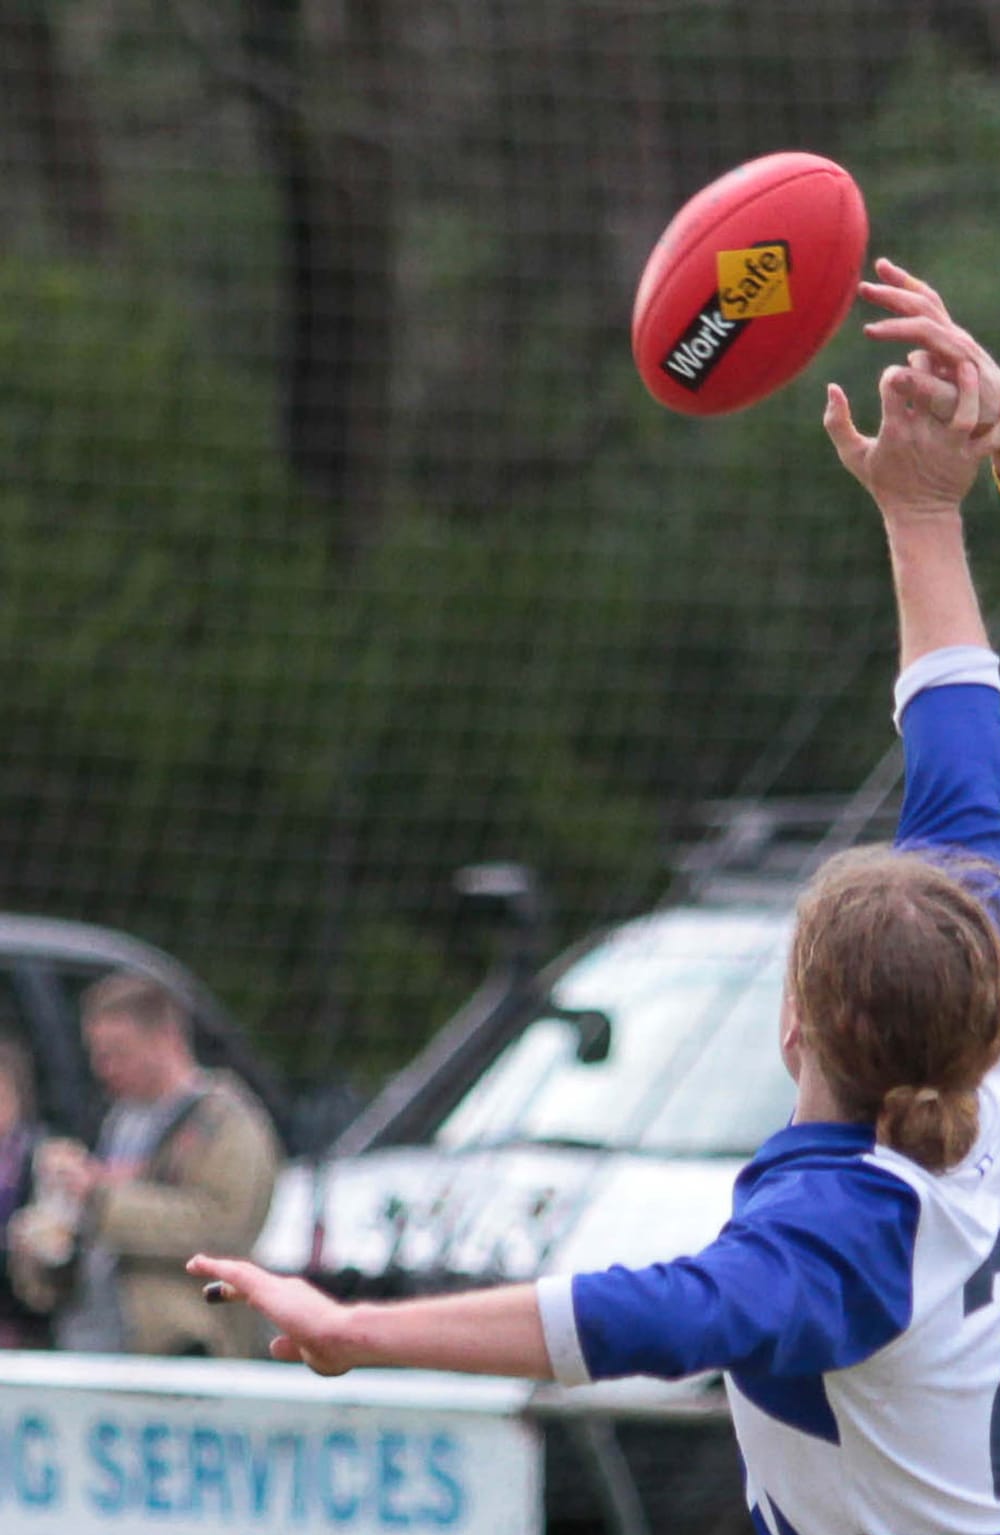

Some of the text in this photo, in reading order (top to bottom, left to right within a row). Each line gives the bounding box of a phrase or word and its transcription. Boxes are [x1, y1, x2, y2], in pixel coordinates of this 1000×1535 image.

[667, 251, 780, 380] Work Safe
[88, 1420, 465, 1528] SERVICES
